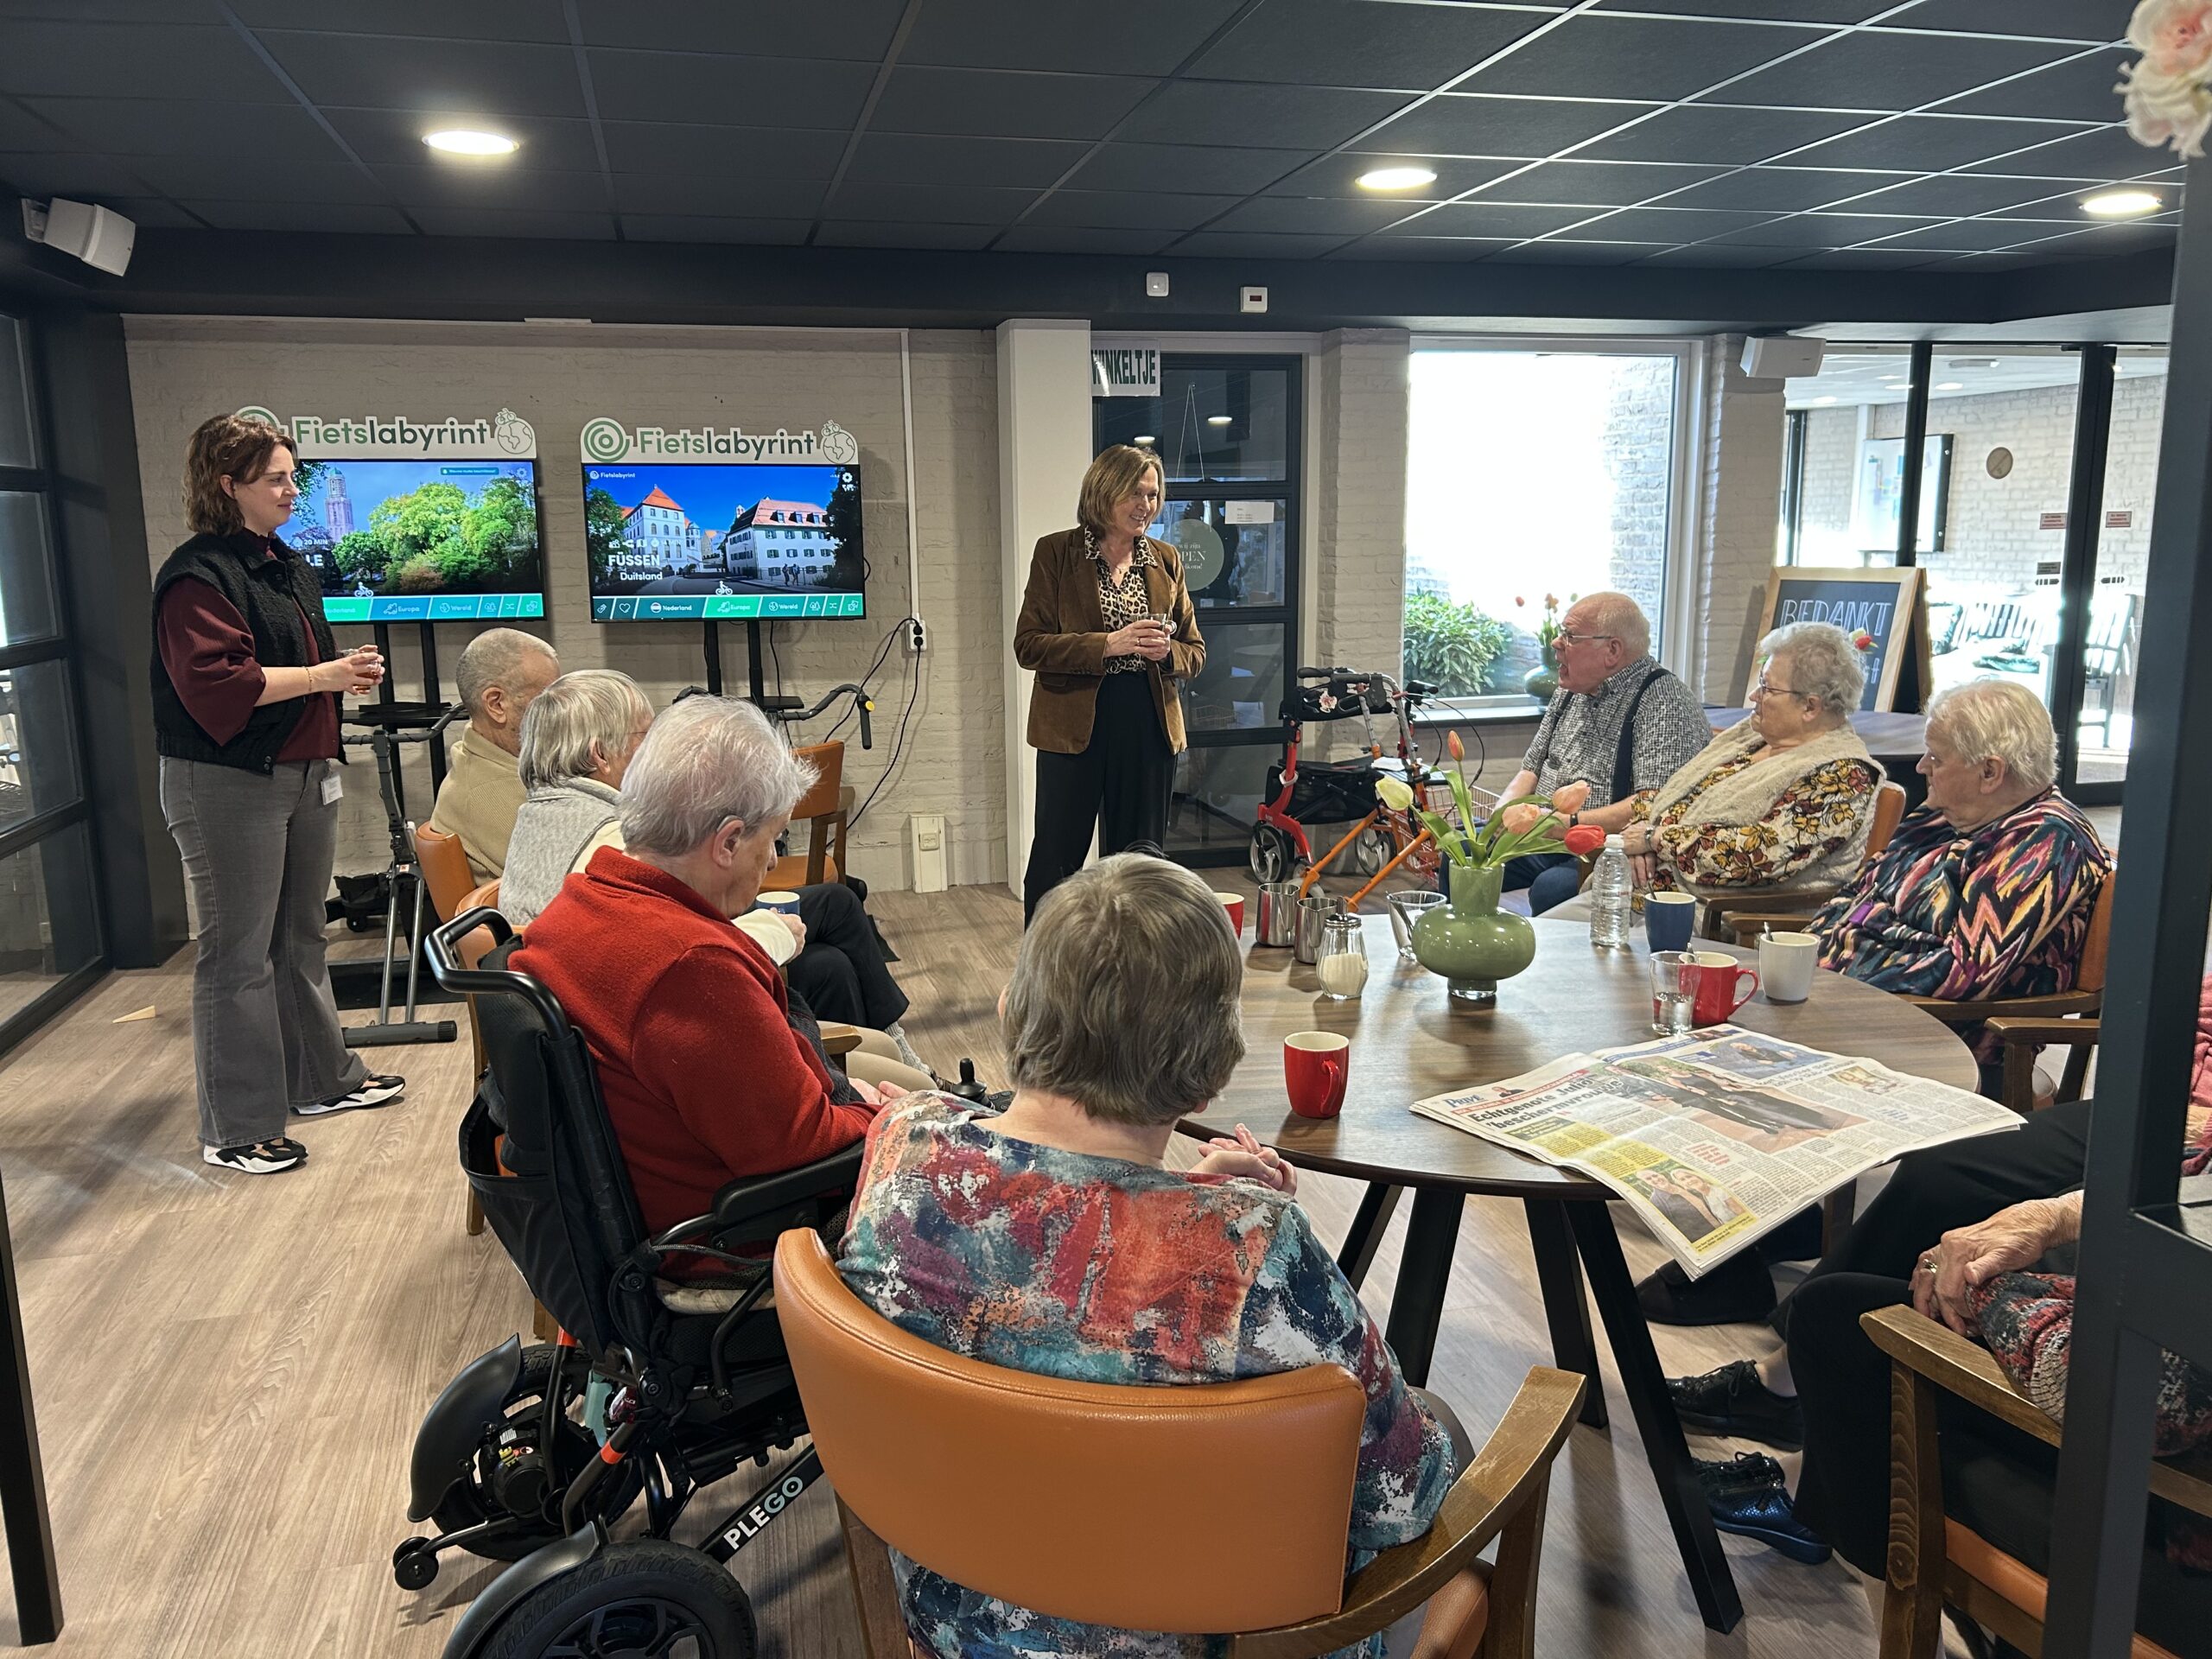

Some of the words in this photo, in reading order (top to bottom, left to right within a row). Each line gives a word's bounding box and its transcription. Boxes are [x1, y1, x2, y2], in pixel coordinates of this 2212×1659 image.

[295, 419, 487, 451] Fietslabyrint
[639, 430, 814, 461] Fietslabyrint
[608, 551, 660, 566] FÜSSEN
[1181, 550, 1207, 562] PEN
[620, 571, 663, 581] Duitsland
[1780, 599, 1892, 637] BEDANKT
[1468, 1094, 1555, 1122] Echtgenote
[723, 1476, 804, 1550] PLEGO
